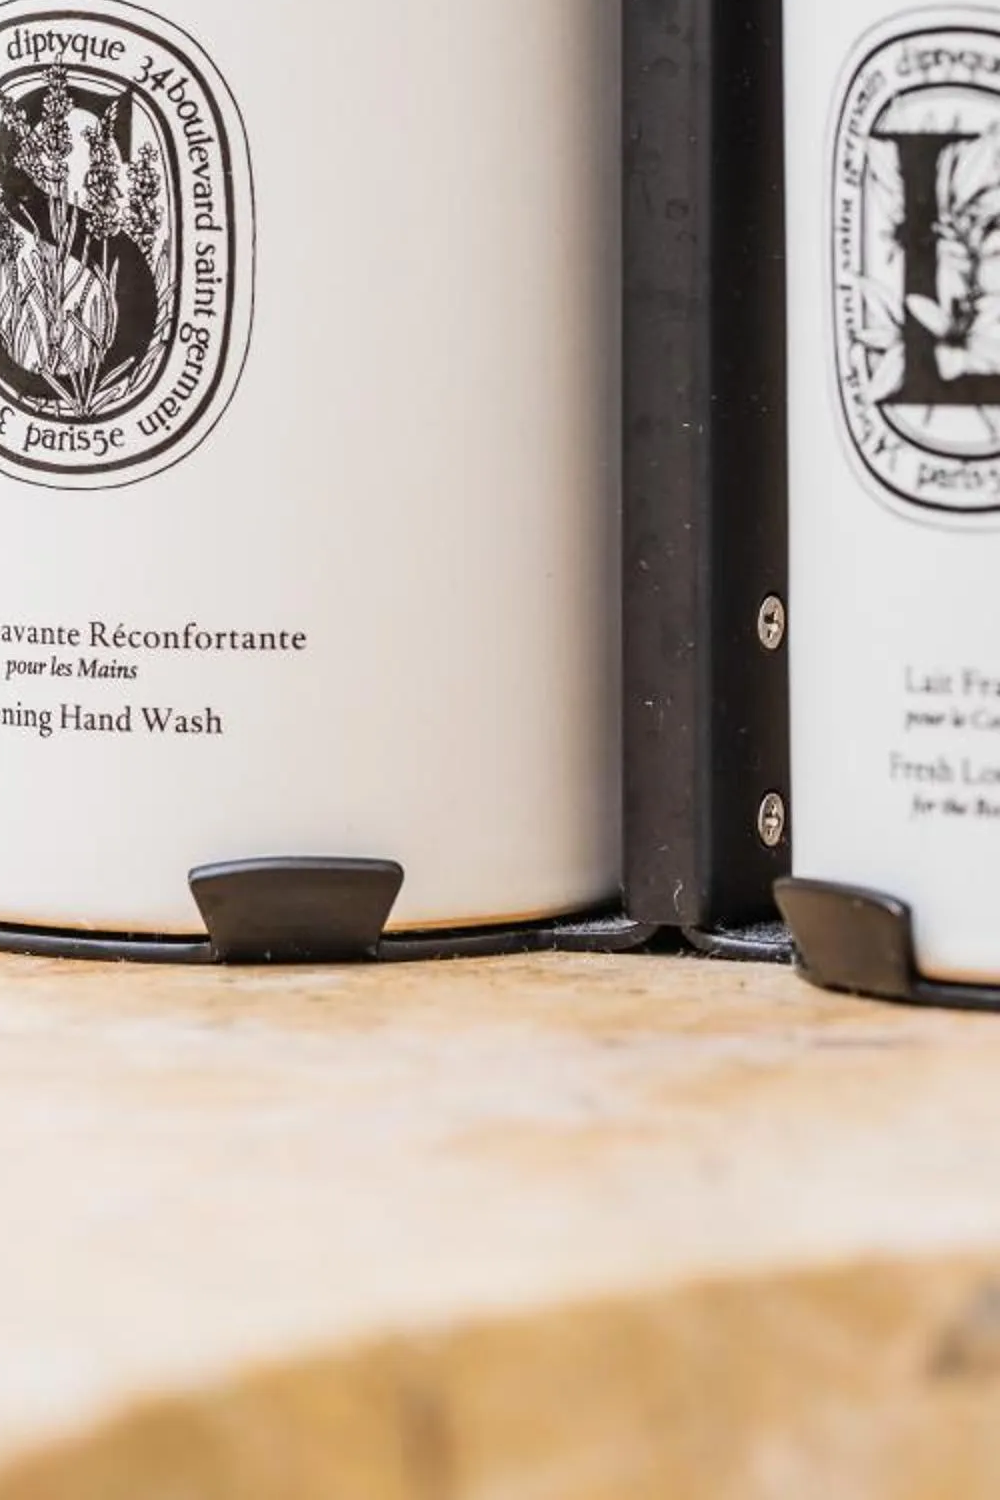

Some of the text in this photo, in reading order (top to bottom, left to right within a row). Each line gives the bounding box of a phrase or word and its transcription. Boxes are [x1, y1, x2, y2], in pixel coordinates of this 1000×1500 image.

[6, 28, 126, 62] diptyque
[194, 241, 222, 319] saint
[137, 321, 211, 435] germain
[88, 621, 308, 651] Réconfortante
[4, 655, 139, 681] pour les Mains
[59, 703, 132, 733] Hand
[141, 706, 224, 735] Wash
